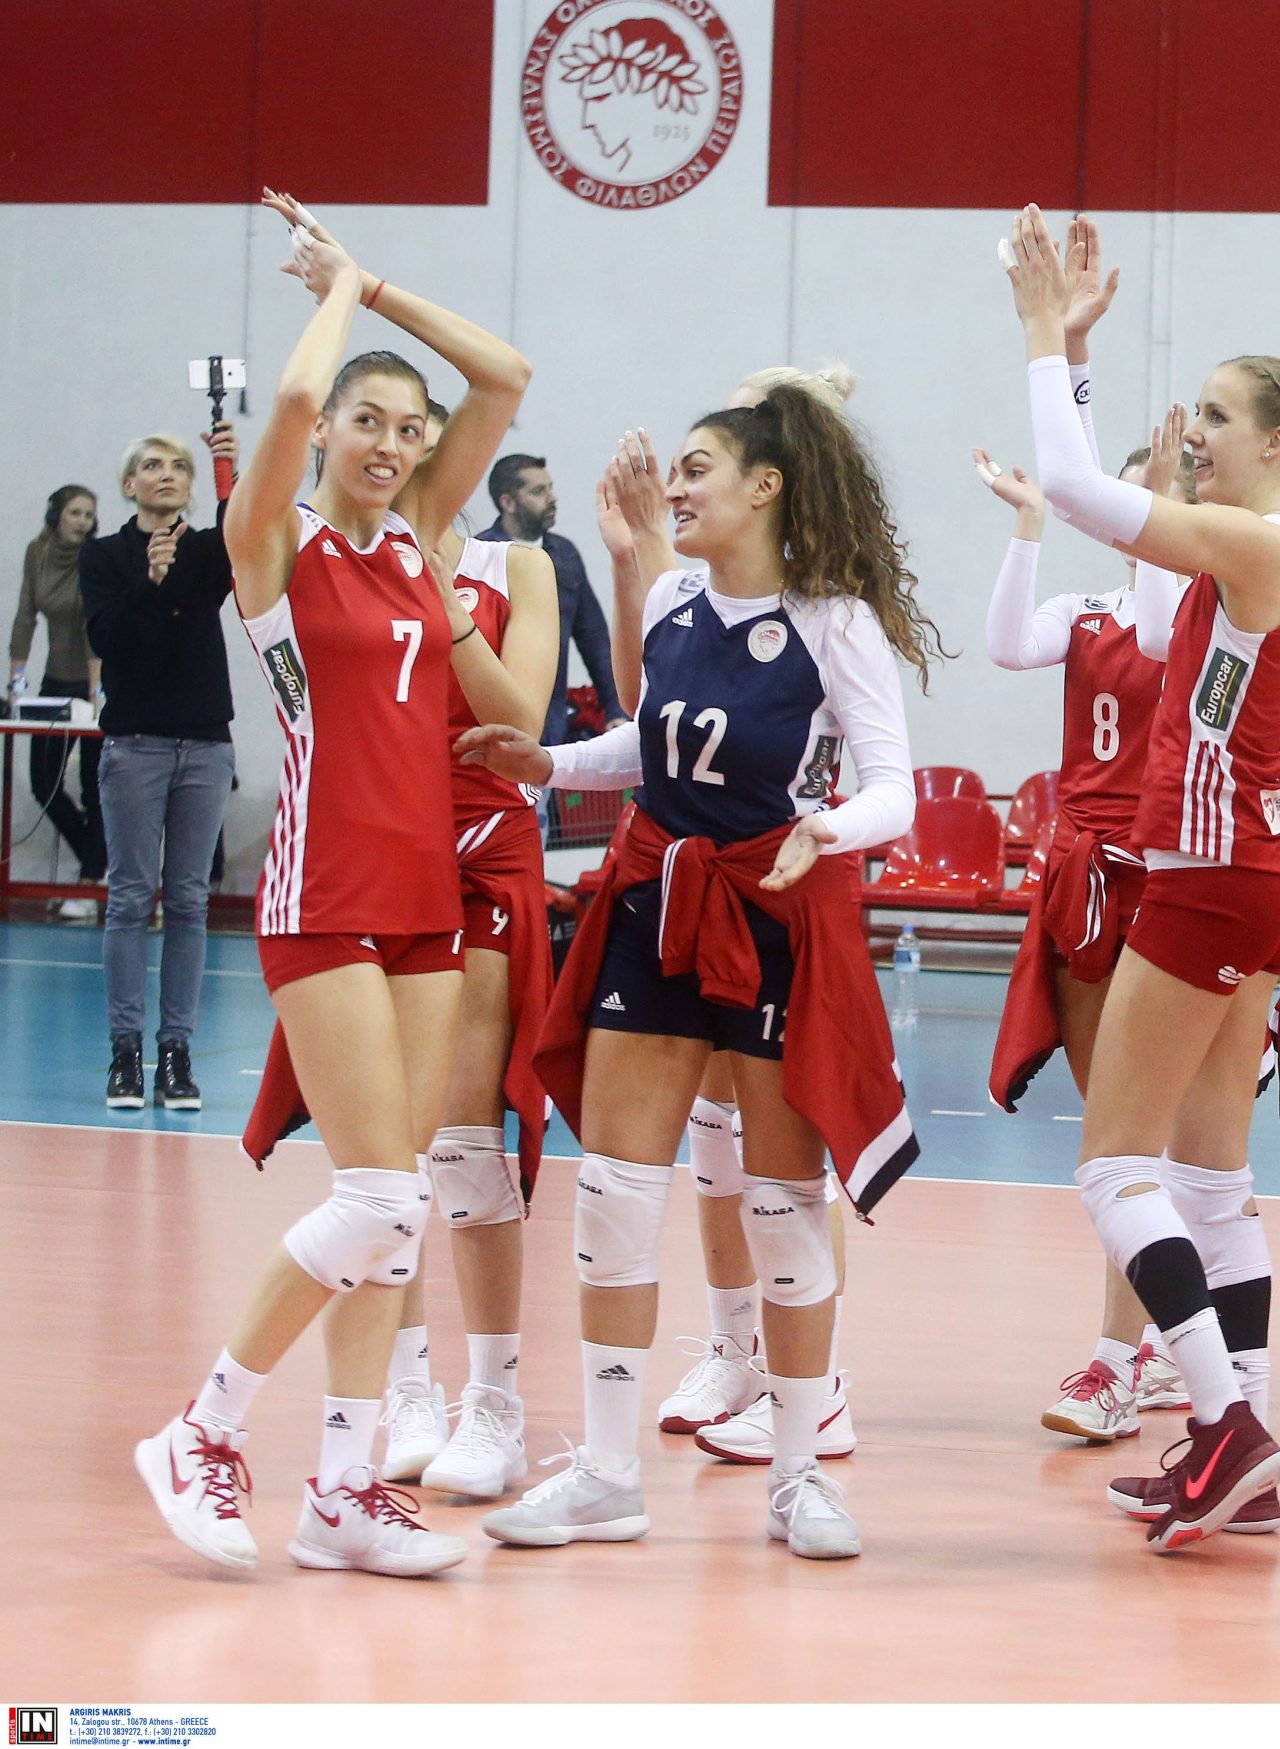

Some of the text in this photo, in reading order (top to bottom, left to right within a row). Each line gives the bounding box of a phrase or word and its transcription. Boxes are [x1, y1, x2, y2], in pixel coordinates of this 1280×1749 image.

[391, 619, 423, 703] 7
[1200, 655, 1234, 724] Europcar
[659, 700, 728, 786] 12
[1093, 692, 1120, 762] 8
[491, 906, 510, 936] 9
